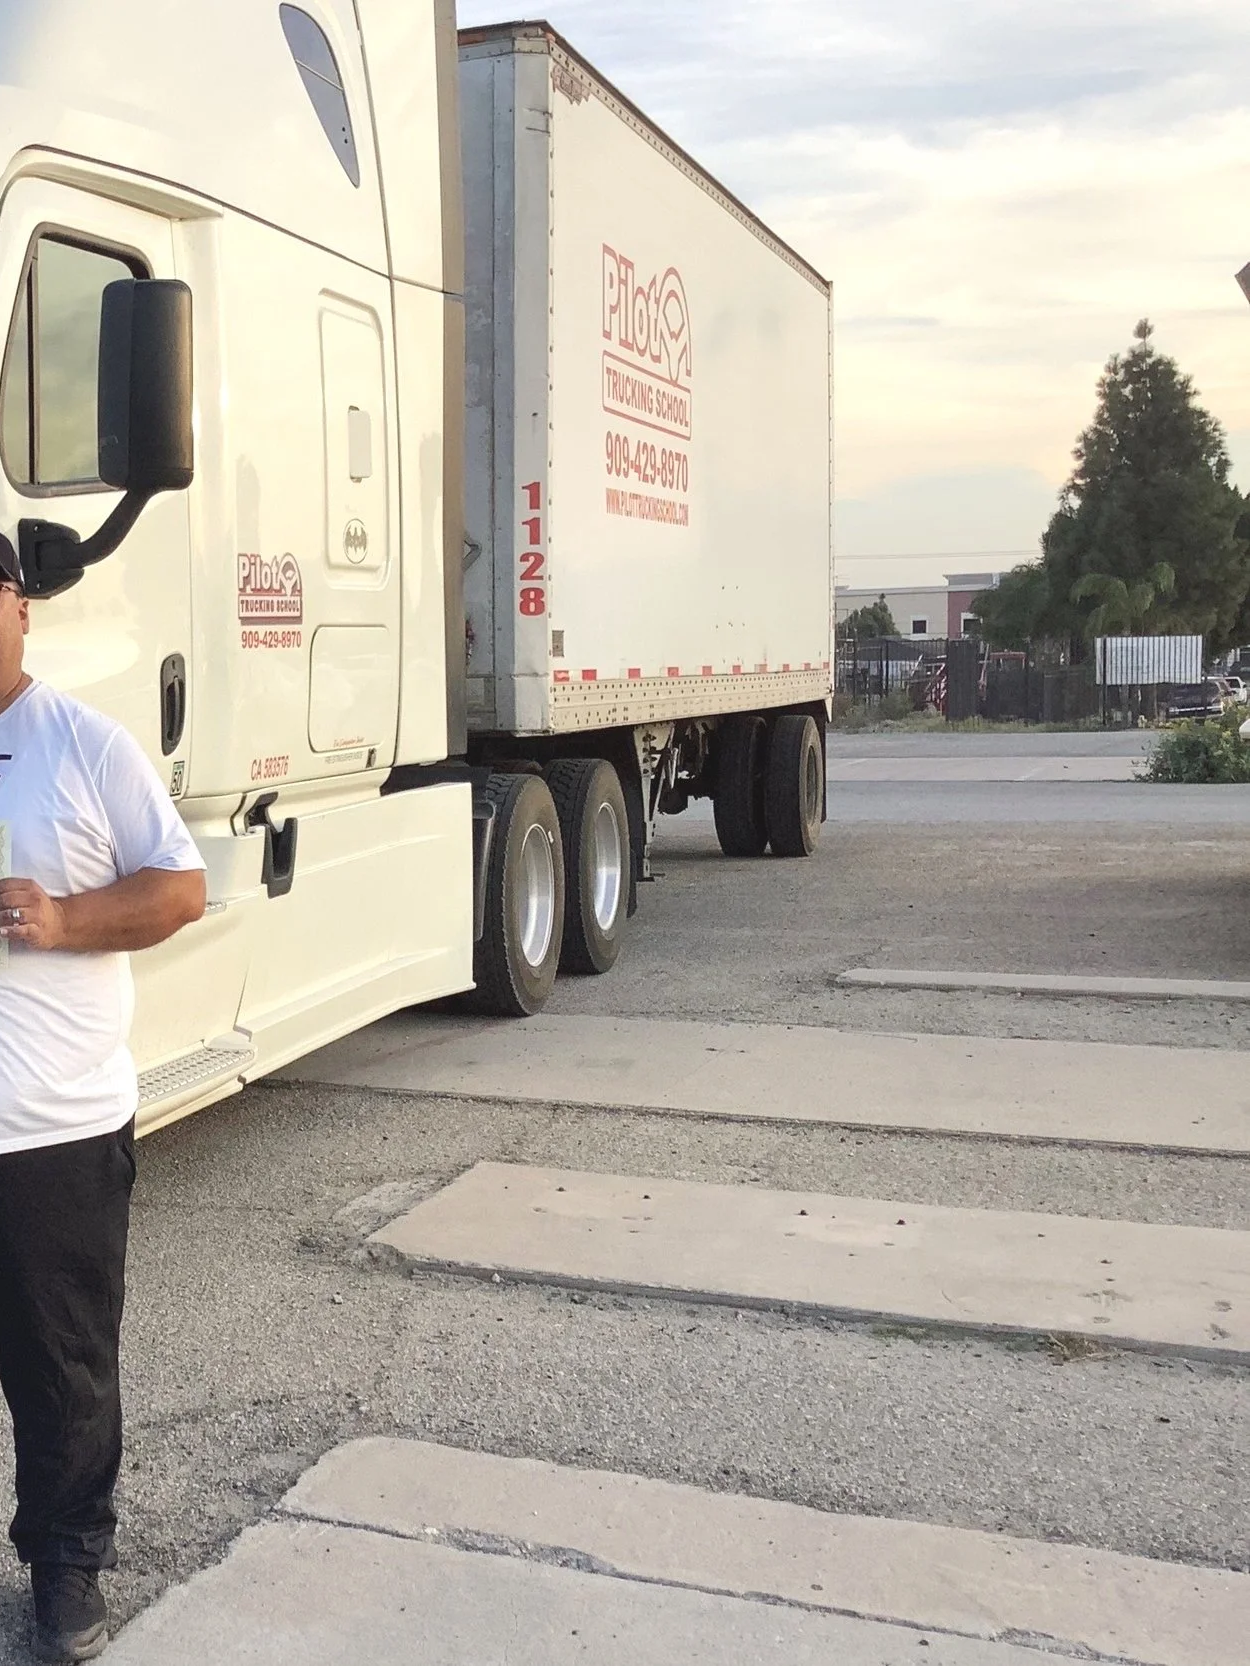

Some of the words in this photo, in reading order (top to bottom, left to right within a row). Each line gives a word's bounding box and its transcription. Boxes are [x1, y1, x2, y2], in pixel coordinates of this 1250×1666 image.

[602, 243, 663, 363] Pilot
[606, 367, 654, 415] TRUCKING
[655, 390, 690, 428] SCHOOL
[605, 430, 689, 493] 909-429-8970
[237, 552, 282, 594] Pilot
[240, 599, 275, 613] TRUCKING
[276, 599, 300, 612] SCHOOL
[241, 630, 302, 649] 909-429-8970
[251, 758, 262, 781] CA
